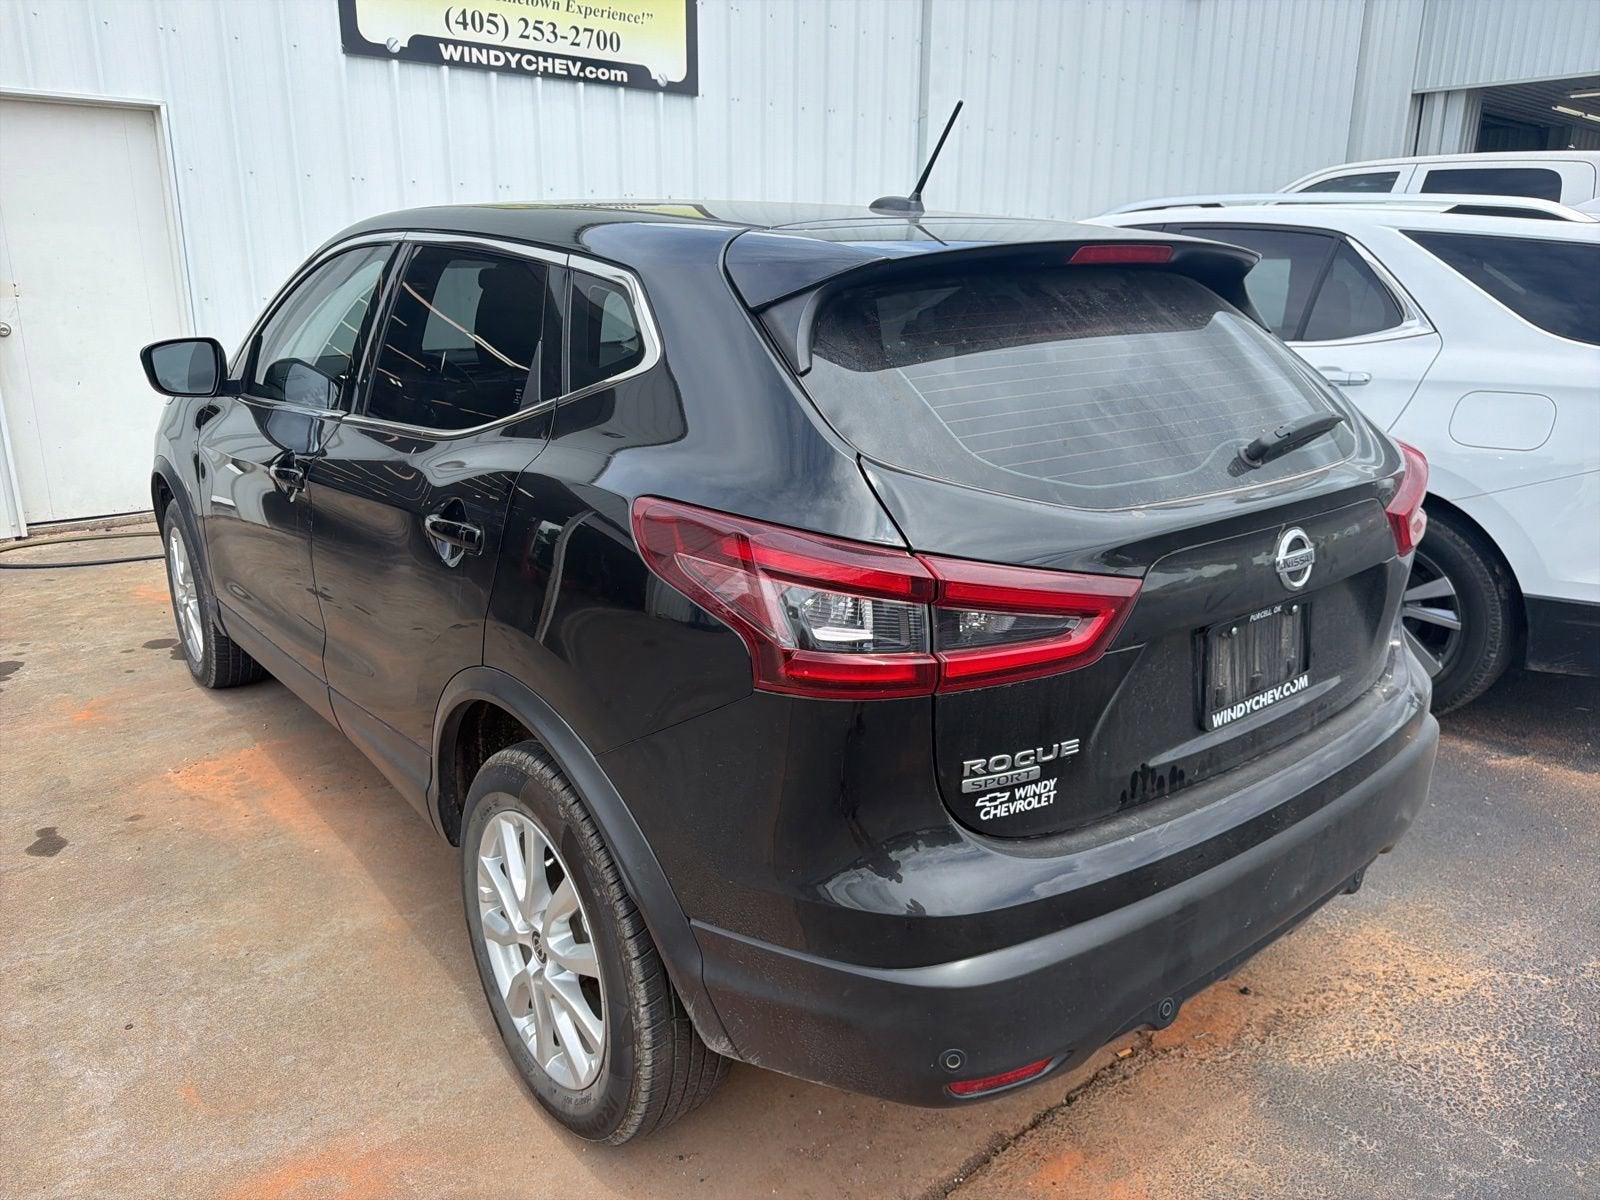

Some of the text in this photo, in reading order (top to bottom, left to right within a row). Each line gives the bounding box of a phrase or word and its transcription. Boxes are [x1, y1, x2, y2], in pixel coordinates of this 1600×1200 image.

[444, 6, 621, 53] (405) 253-2700
[438, 42, 629, 83] WINDYCHEV.com
[1212, 674, 1308, 728] WINDYCHEV.COM
[963, 739, 1080, 777] ROGUE
[970, 769, 1035, 791] SPORT
[1014, 777, 1058, 800] WINDY
[980, 790, 1058, 820] CHEVROLET
